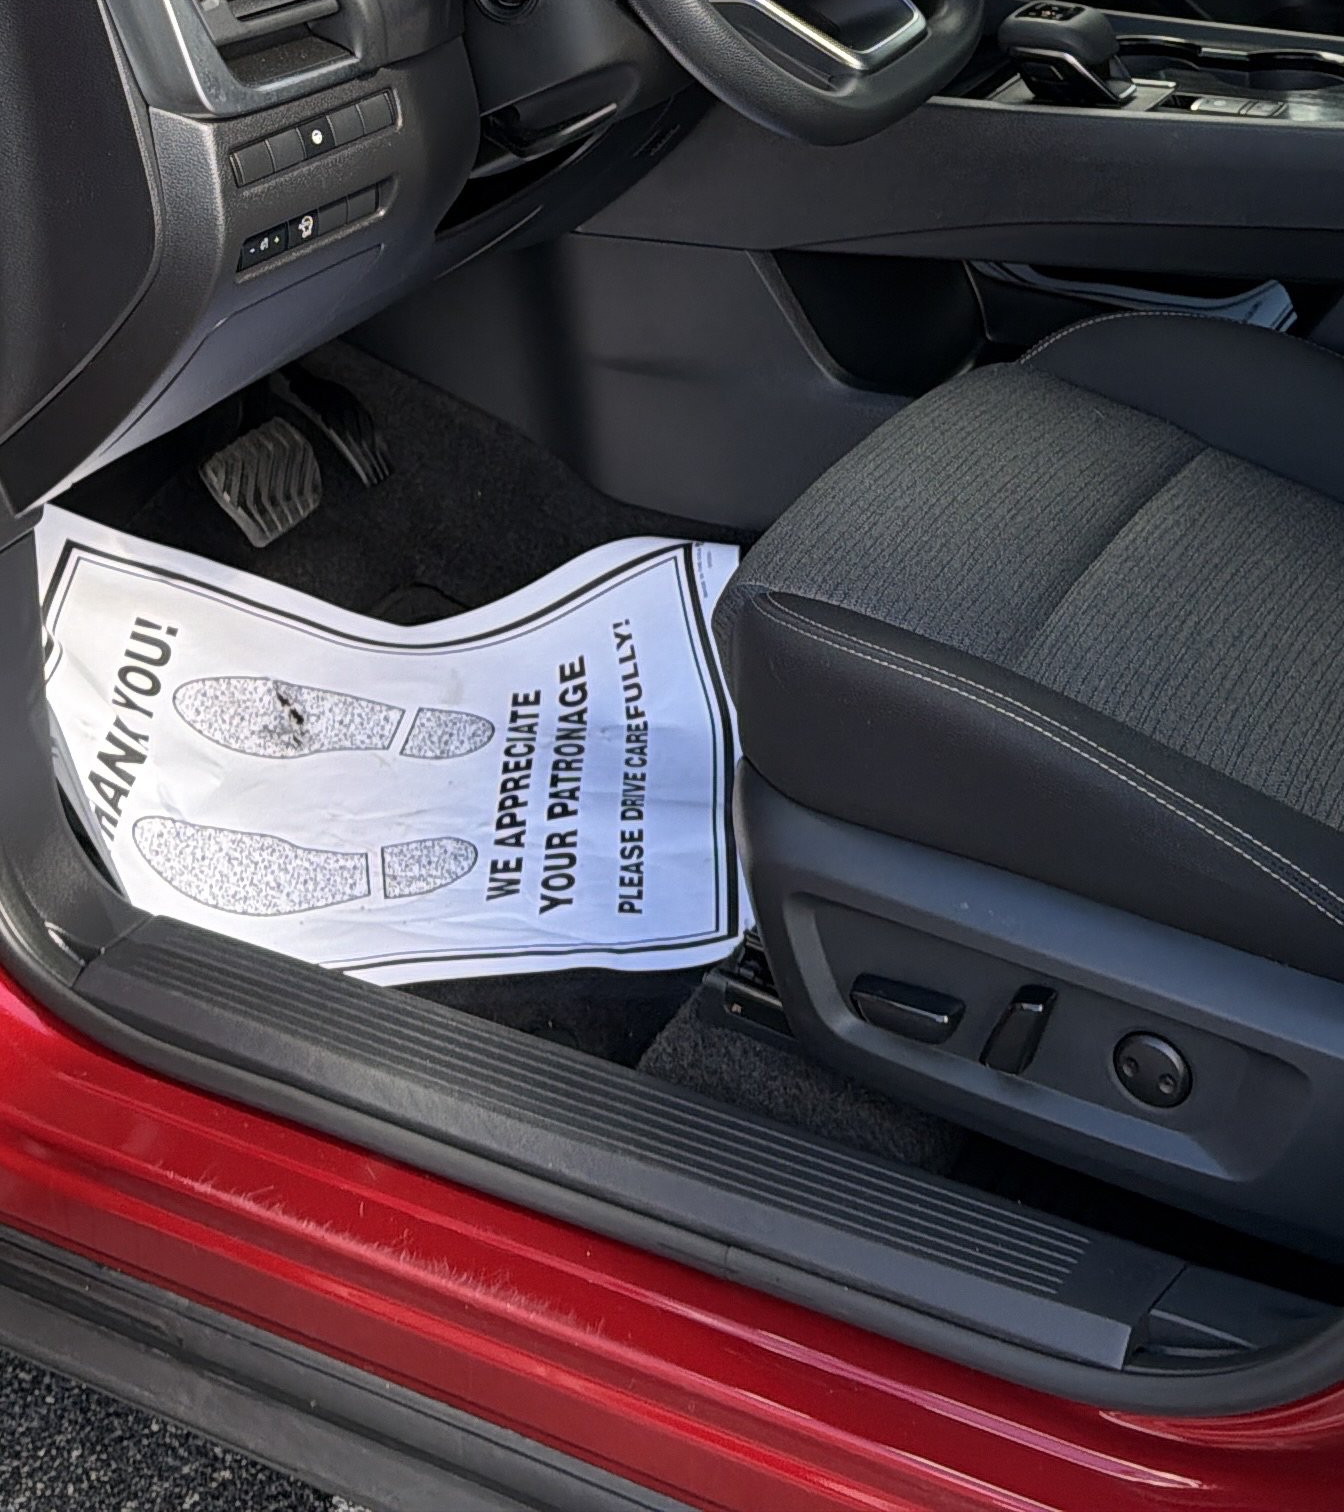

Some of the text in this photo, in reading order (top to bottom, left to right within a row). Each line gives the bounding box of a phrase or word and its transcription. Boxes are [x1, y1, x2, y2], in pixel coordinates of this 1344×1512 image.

[87, 616, 179, 842] HANK YOU!
[486, 689, 541, 901] WE APPRECIATE
[539, 654, 588, 915] YOUR PATRONAGE
[612, 618, 649, 915] PLEASE DRIVE CAREFULLY!
